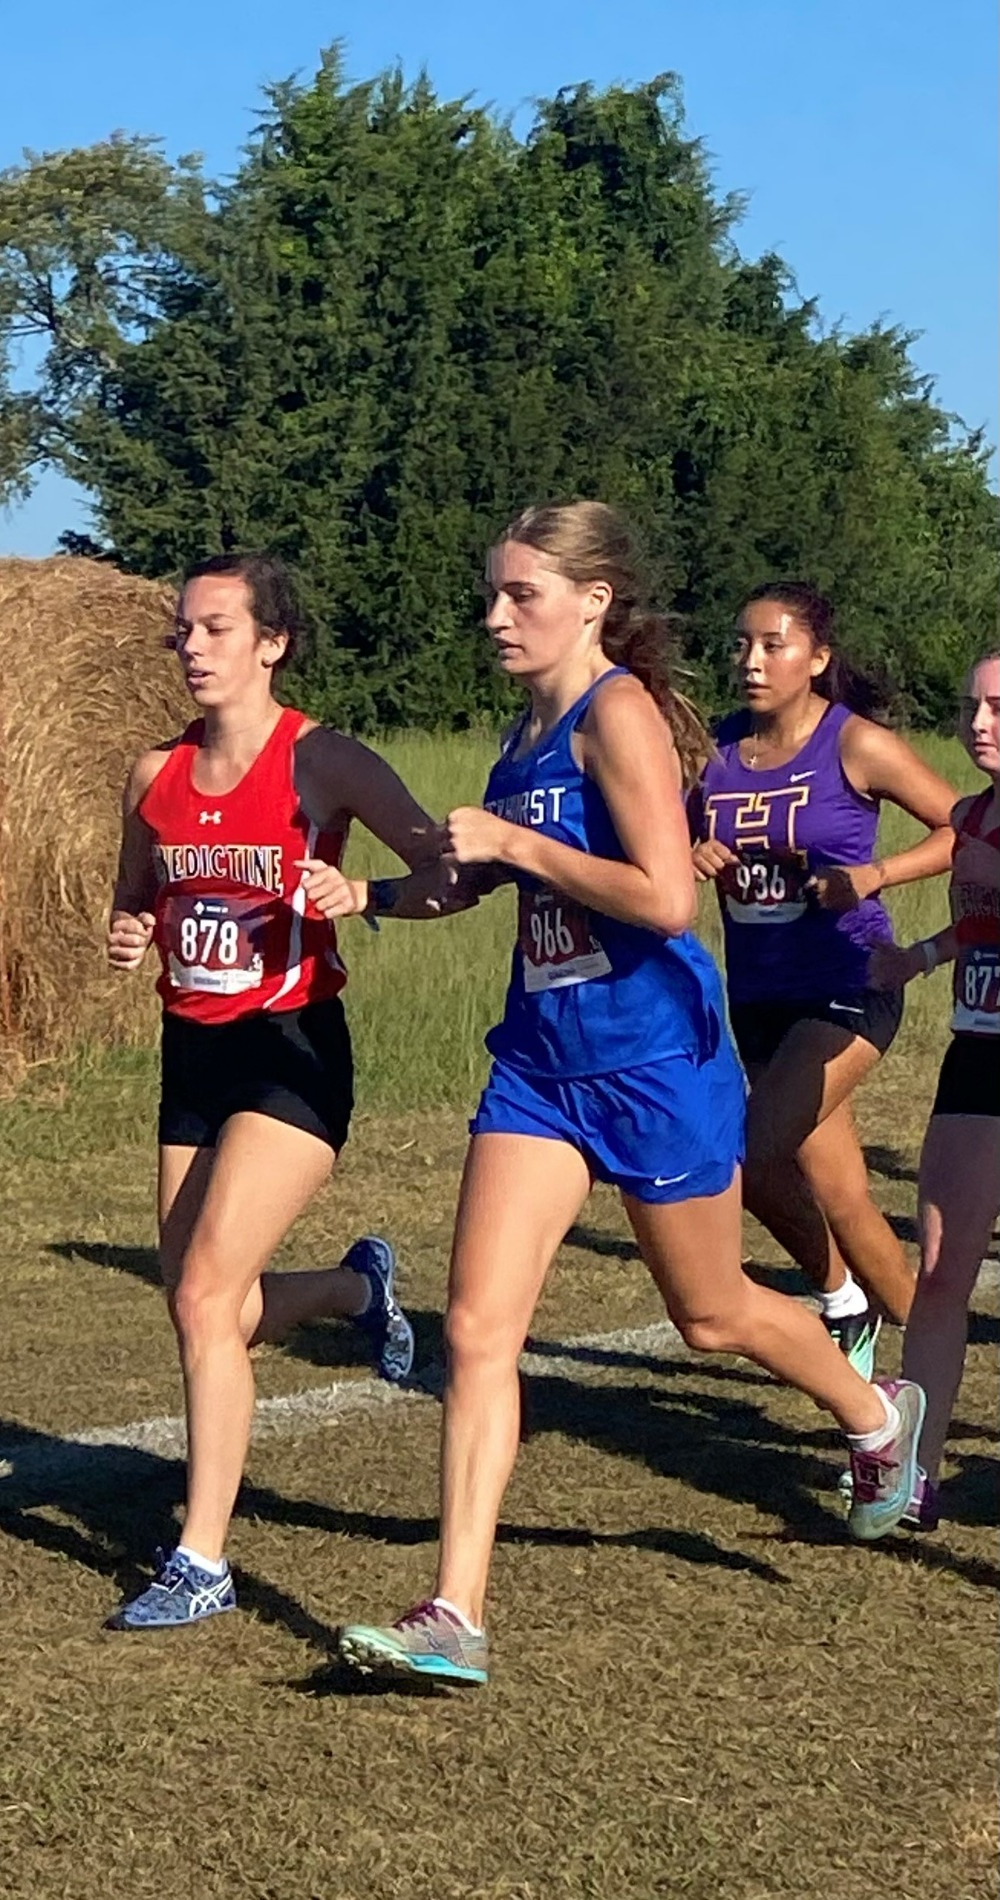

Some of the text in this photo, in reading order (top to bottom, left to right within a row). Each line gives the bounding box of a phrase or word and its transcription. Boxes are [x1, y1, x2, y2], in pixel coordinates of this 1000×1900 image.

[736, 863, 786, 901] 936
[181, 917, 238, 965] 878
[530, 907, 574, 960] 966
